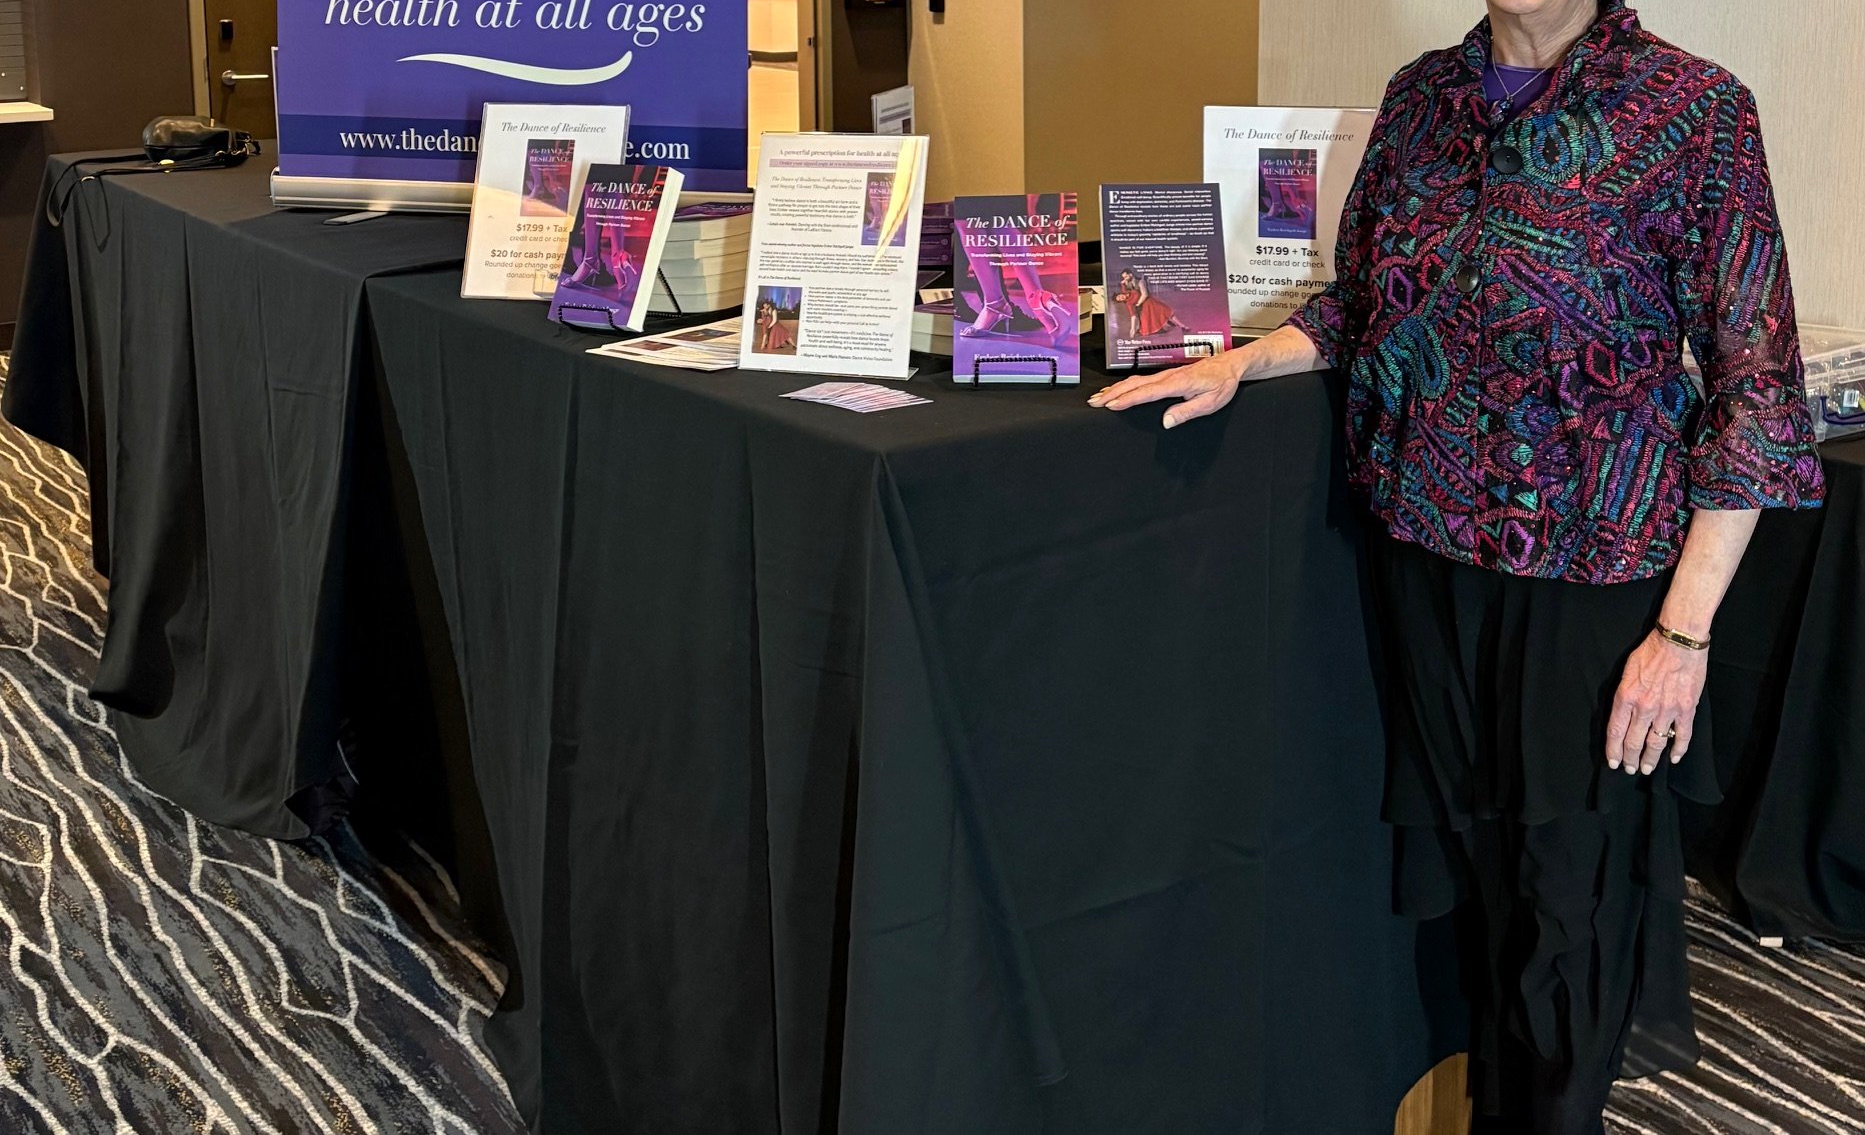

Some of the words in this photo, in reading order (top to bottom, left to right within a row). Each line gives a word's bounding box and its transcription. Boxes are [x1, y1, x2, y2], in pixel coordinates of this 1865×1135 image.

[606, 1, 707, 48] ages
[501, 121, 519, 132] The
[519, 122, 549, 132] Dance
[550, 122, 562, 135] of
[561, 123, 607, 134] Resilience
[1223, 127, 1245, 140] The
[1247, 128, 1283, 140] Dance
[1285, 128, 1299, 143] of
[1299, 129, 1355, 142] Resilience
[590, 182, 608, 193] The
[608, 182, 647, 195] DANCE
[646, 185, 658, 198] of
[585, 197, 654, 212] RESILIENCE
[516, 223, 544, 232] $17.99
[553, 224, 568, 233] Tax
[966, 216, 990, 229] The
[992, 214, 1051, 229] DANCE
[1054, 214, 1071, 230] of
[965, 232, 1069, 247] RESILIENCE
[490, 249, 508, 258] $20
[509, 249, 523, 258] for
[523, 250, 544, 259] cash
[1256, 245, 1290, 256] $17.99
[1301, 247, 1320, 257] Tax
[1249, 258, 1271, 266] credit
[1273, 259, 1291, 267] card
[1302, 260, 1326, 269] check
[1228, 274, 1249, 284] $20
[1251, 275, 1267, 284] for
[1268, 277, 1292, 286] cash
[1295, 279, 1331, 289] payme
[1228, 287, 1257, 295] ounded
[1271, 289, 1299, 298] change
[1250, 300, 1288, 308] donations
